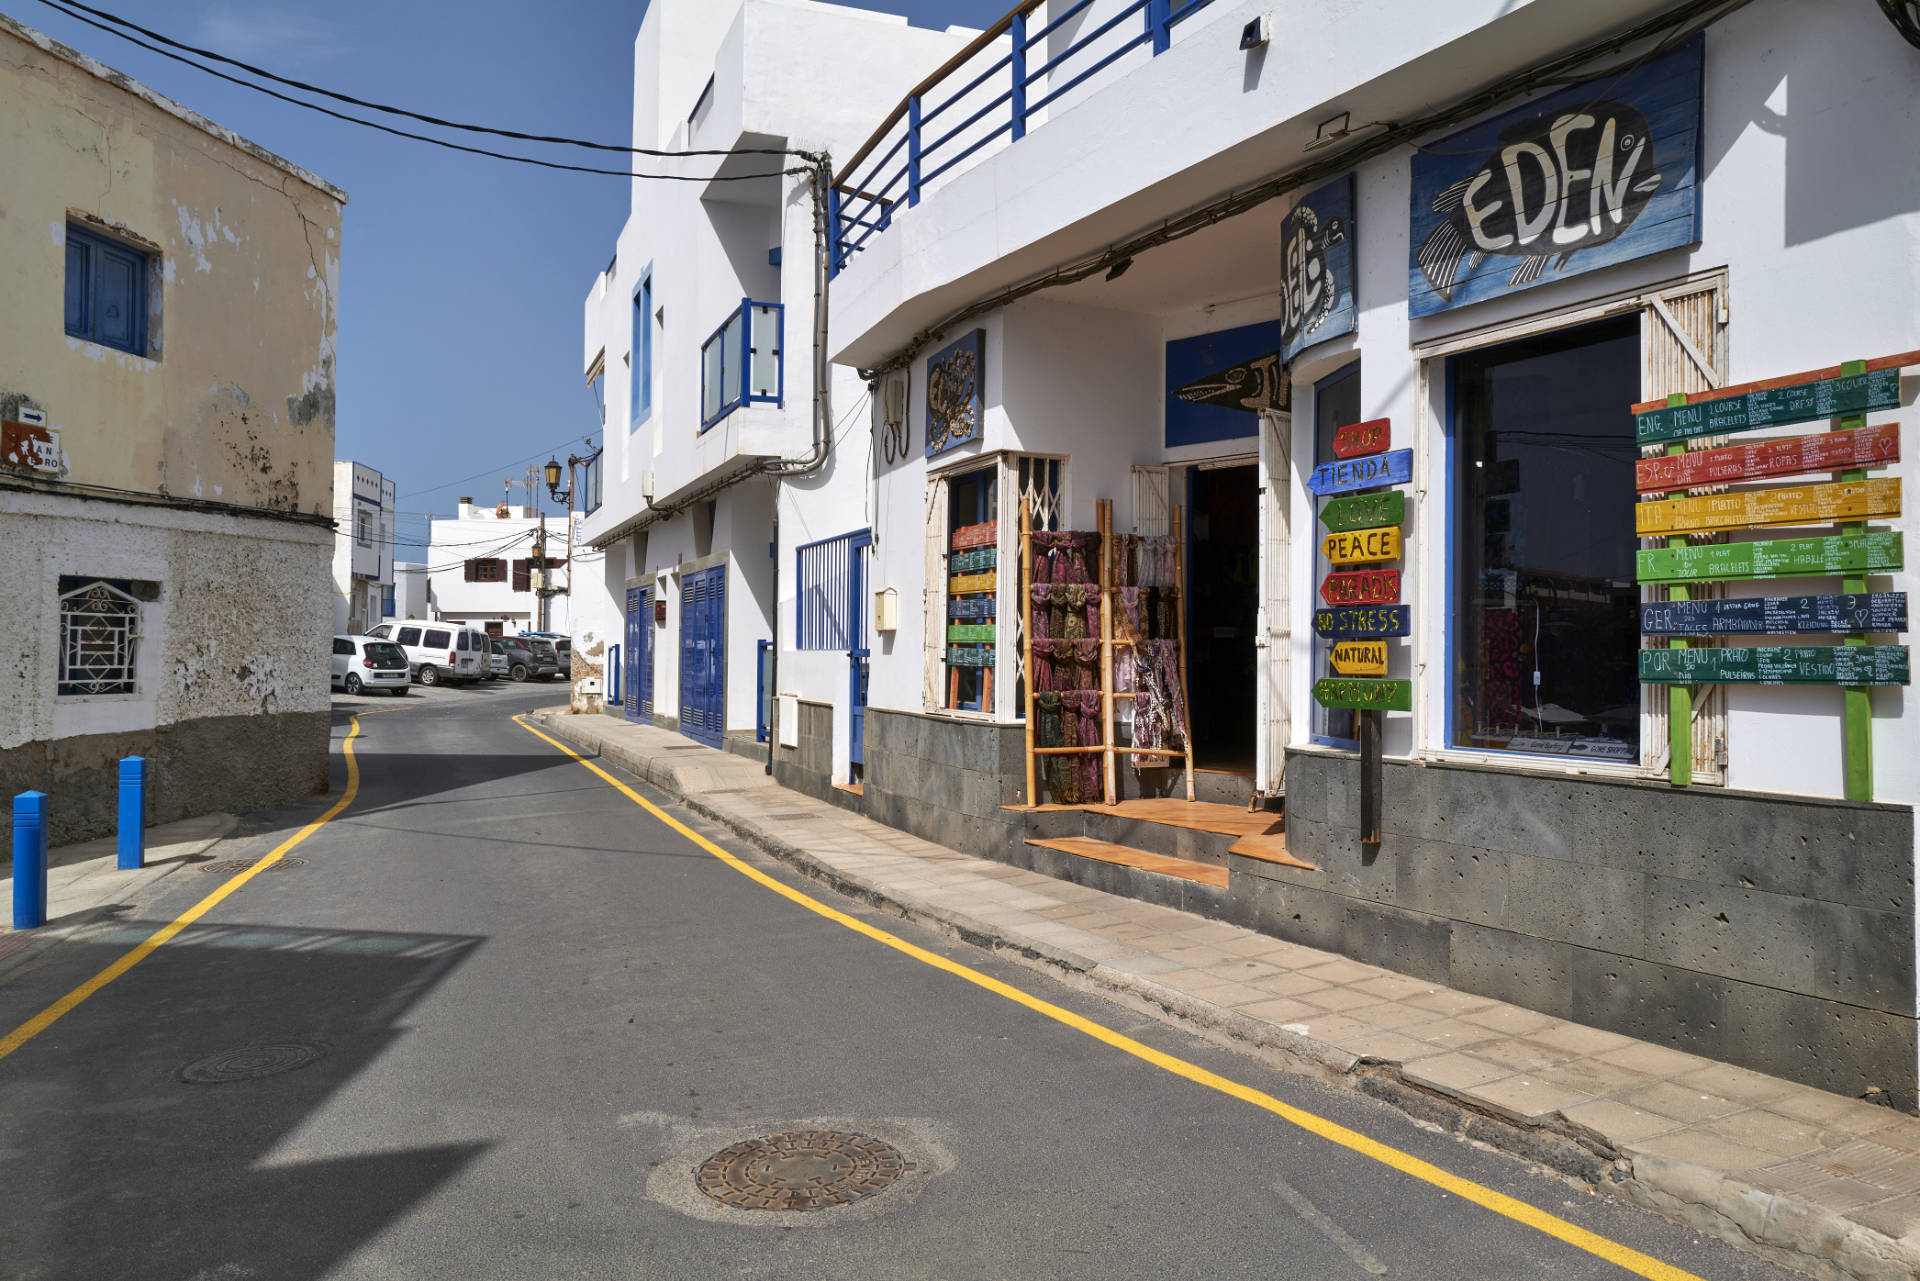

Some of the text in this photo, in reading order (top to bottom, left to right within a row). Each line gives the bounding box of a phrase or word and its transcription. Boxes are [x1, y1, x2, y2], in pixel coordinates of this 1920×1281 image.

[1462, 113, 1647, 252] EDEN
[1673, 406, 1703, 427] MENU
[1340, 427, 1383, 453] SHOP
[1677, 451, 1703, 470] MENU
[1337, 498, 1391, 527] LOVE
[1328, 532, 1391, 560] PEACE
[1676, 548, 1703, 560] MENU
[1328, 574, 1399, 602] PARADIS
[1801, 598, 1809, 609] 2
[1317, 609, 1400, 632] NO STRESS
[1334, 645, 1385, 666] NATURAL
[1677, 648, 1708, 665] MENU
[1783, 648, 1792, 661] 2
